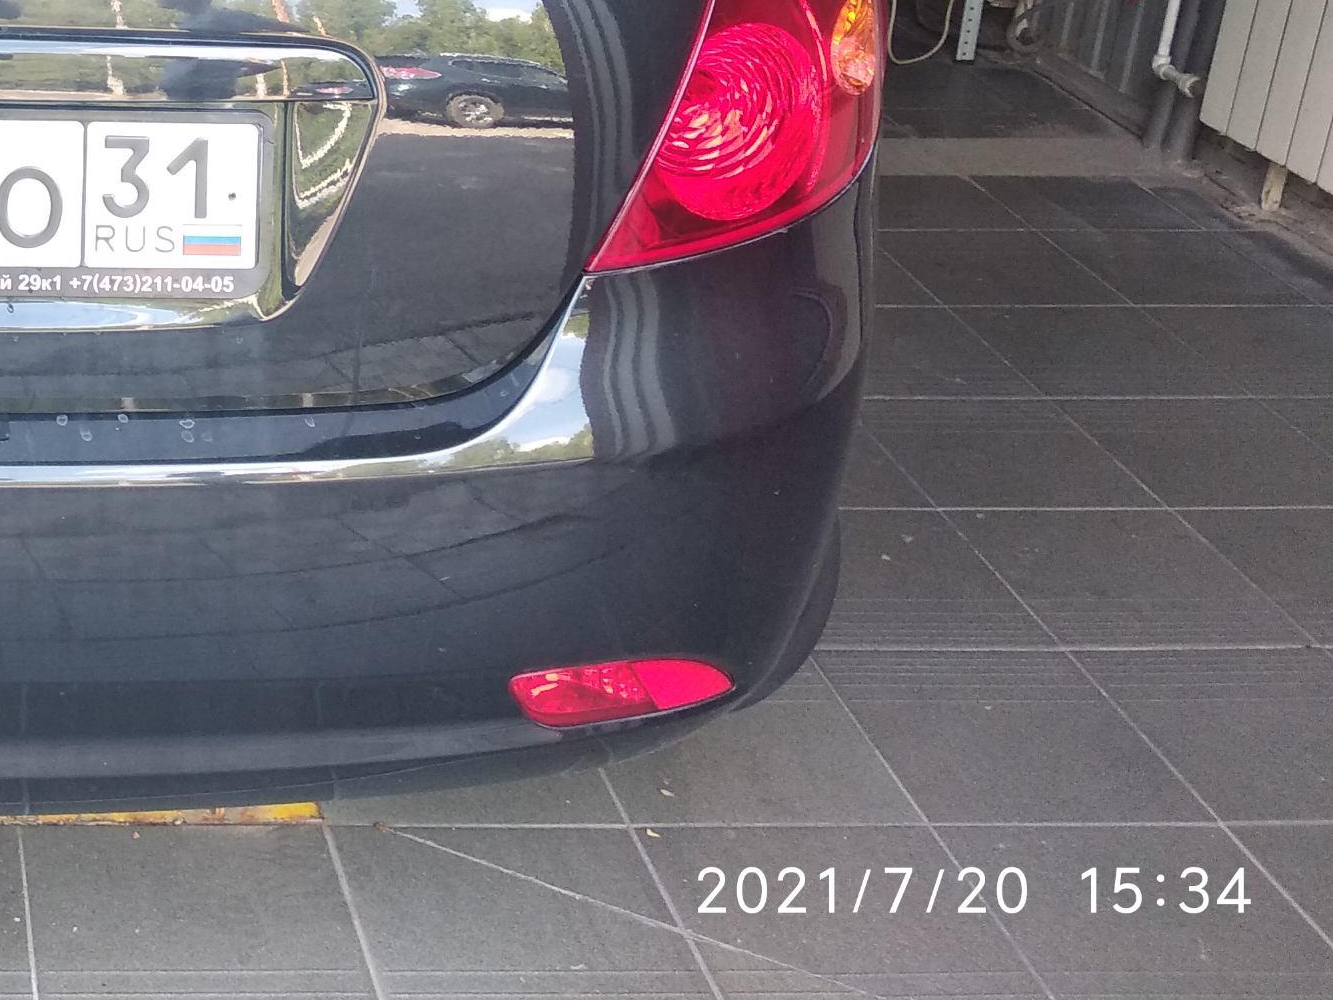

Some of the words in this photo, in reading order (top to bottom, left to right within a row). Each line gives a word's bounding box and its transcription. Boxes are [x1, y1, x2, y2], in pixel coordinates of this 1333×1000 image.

[102, 135, 209, 219] 31
[95, 224, 175, 253] RUS
[18, 275, 62, 292] 29к1
[69, 274, 235, 294] +7(473)211-04-05
